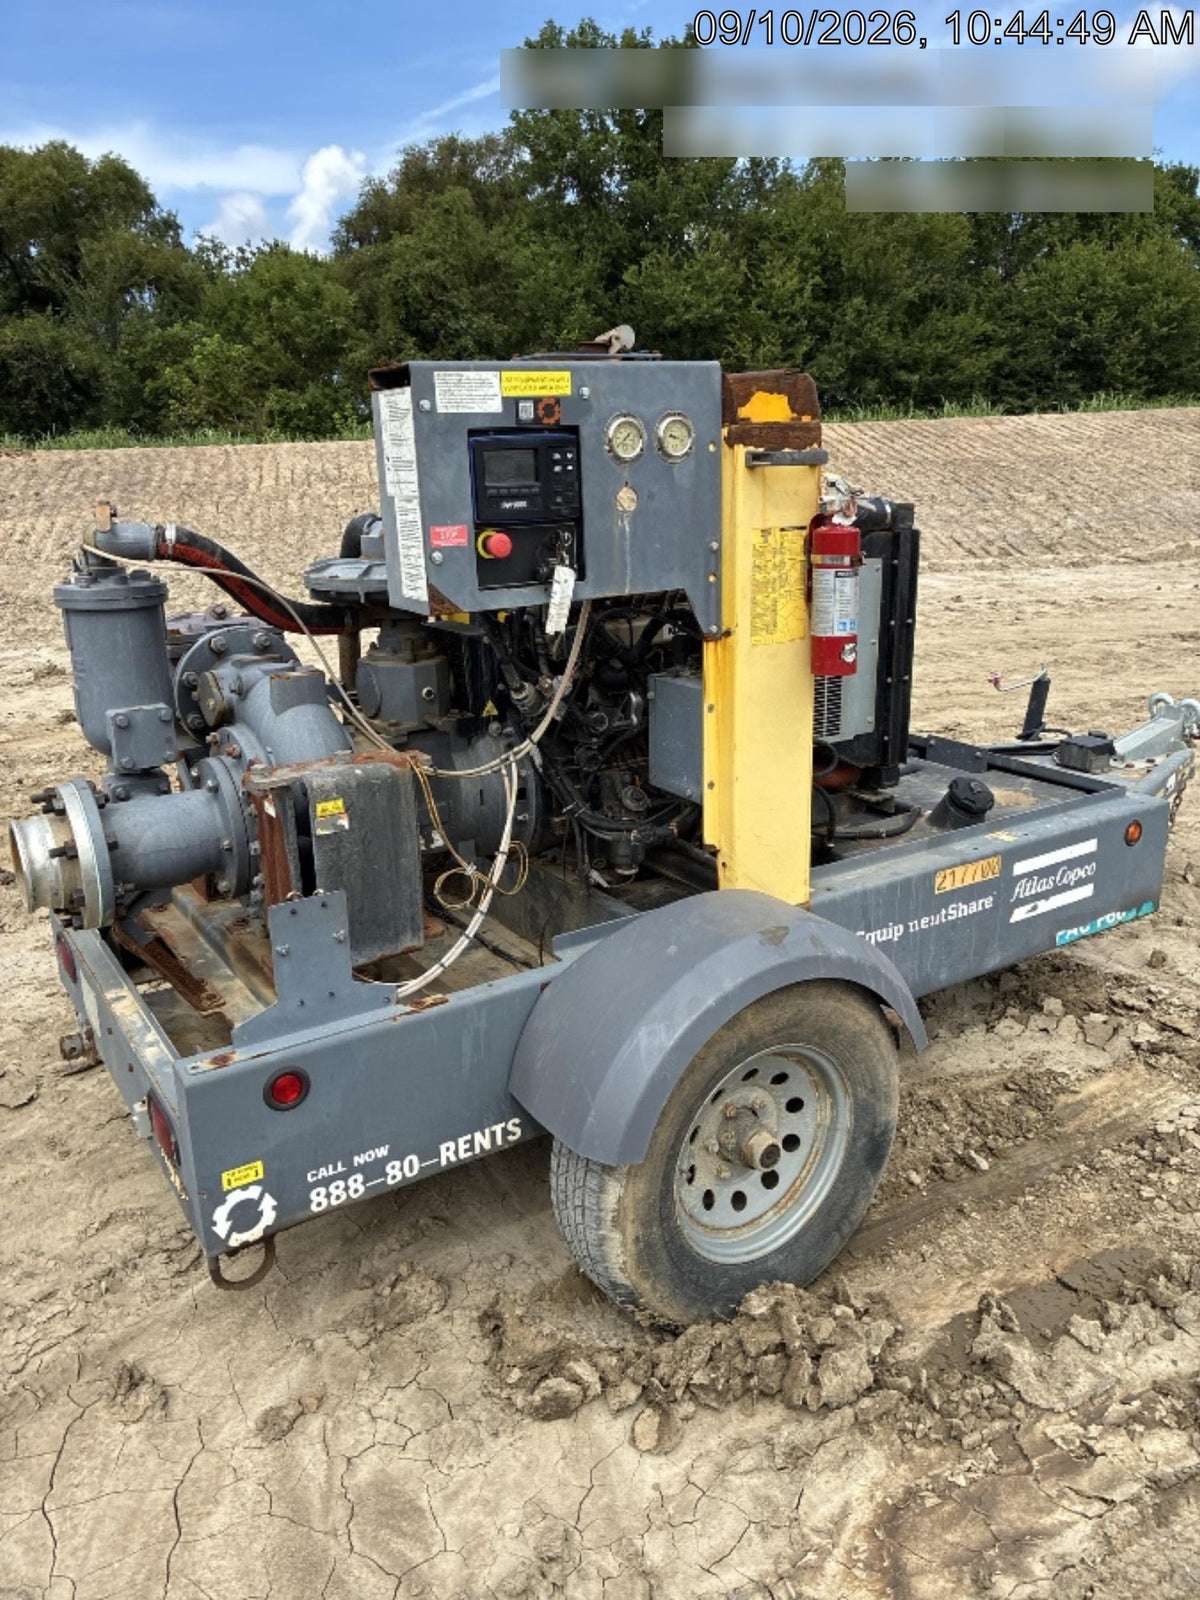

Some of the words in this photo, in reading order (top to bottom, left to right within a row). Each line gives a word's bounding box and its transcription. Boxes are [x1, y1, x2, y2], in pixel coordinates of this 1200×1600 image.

[1010, 875, 1055, 902] Atlas
[1055, 862, 1097, 887] Copco
[306, 1160, 348, 1183] CALL
[353, 1144, 390, 1167] NOW
[309, 1117, 522, 1213] 888-80-RENTS
